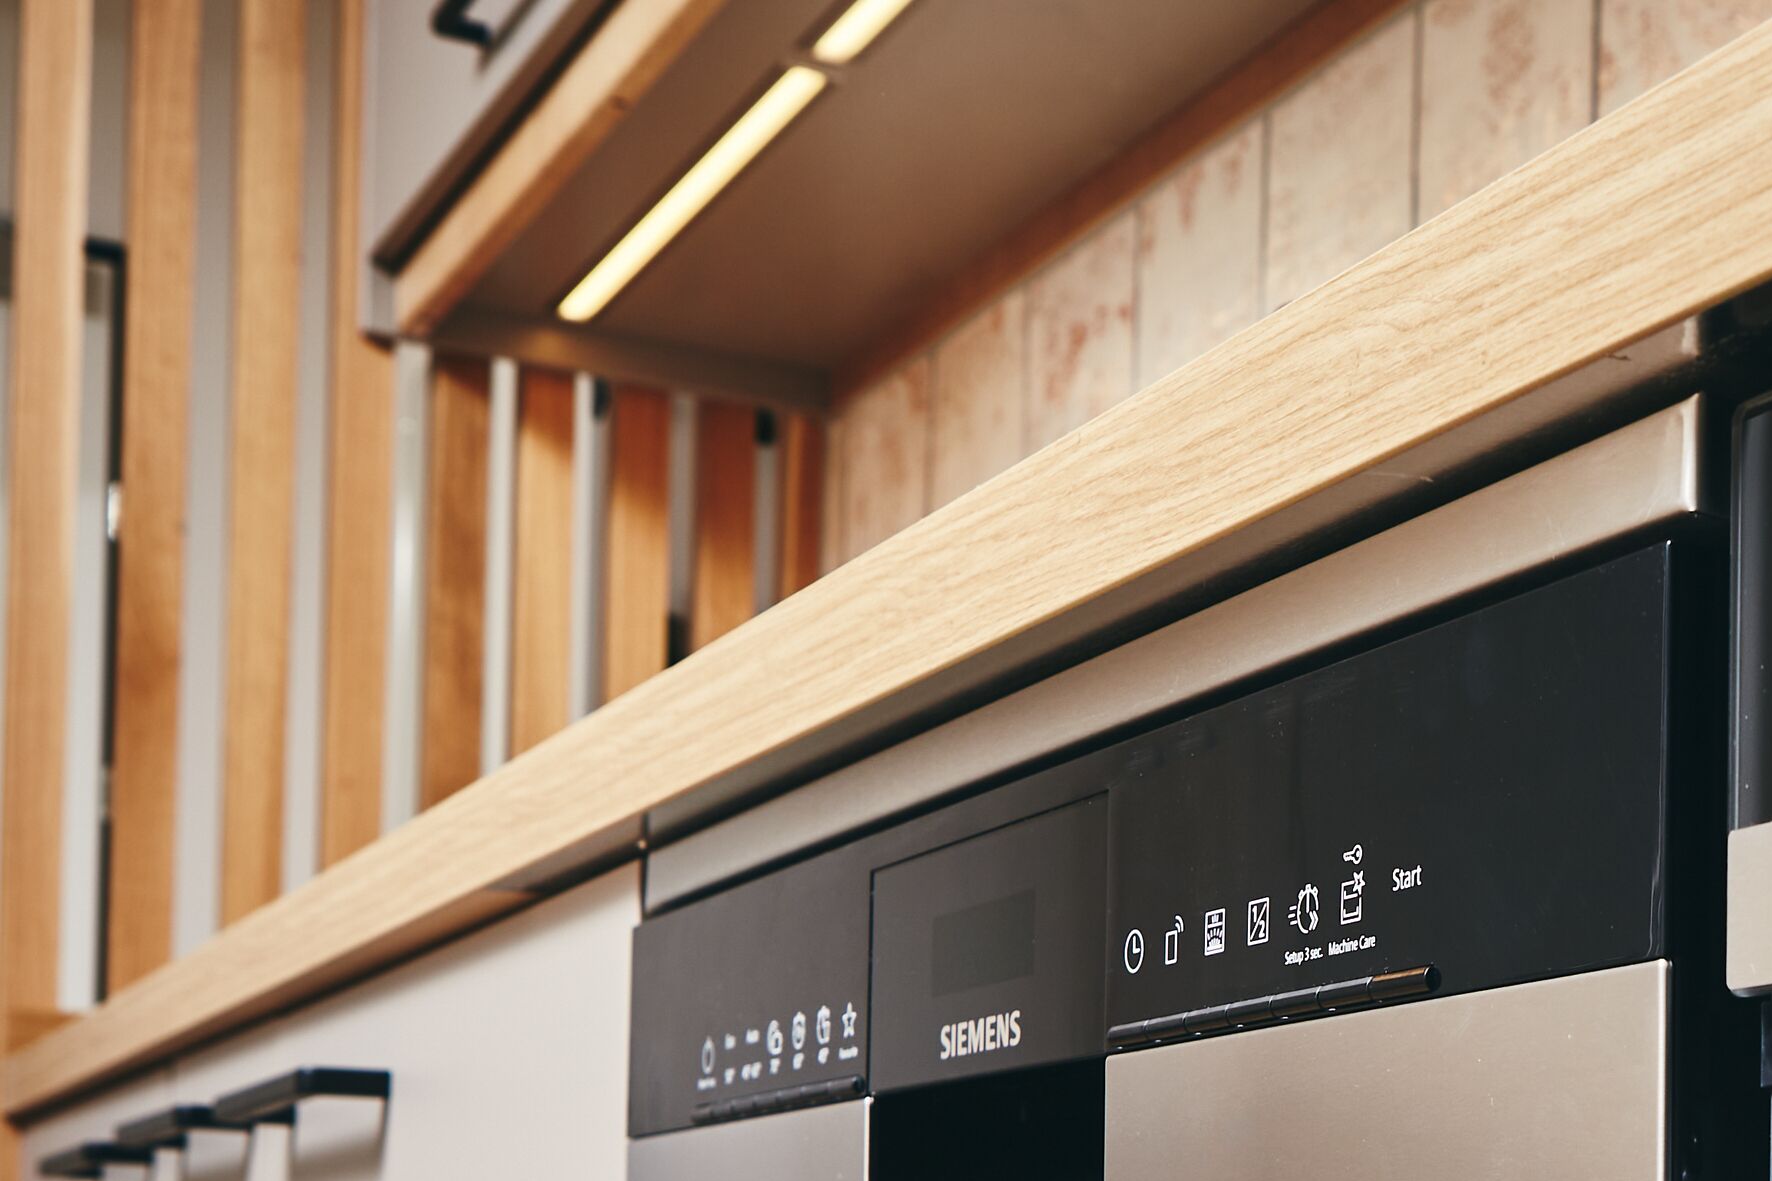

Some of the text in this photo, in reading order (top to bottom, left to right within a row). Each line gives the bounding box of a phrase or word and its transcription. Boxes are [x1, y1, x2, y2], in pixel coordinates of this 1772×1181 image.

[1392, 864, 1422, 892] Start
[1284, 947, 1324, 966] Setup 3 sec.
[1328, 935, 1376, 956] Machine Care
[940, 1009, 1022, 1060] SIEMENS
